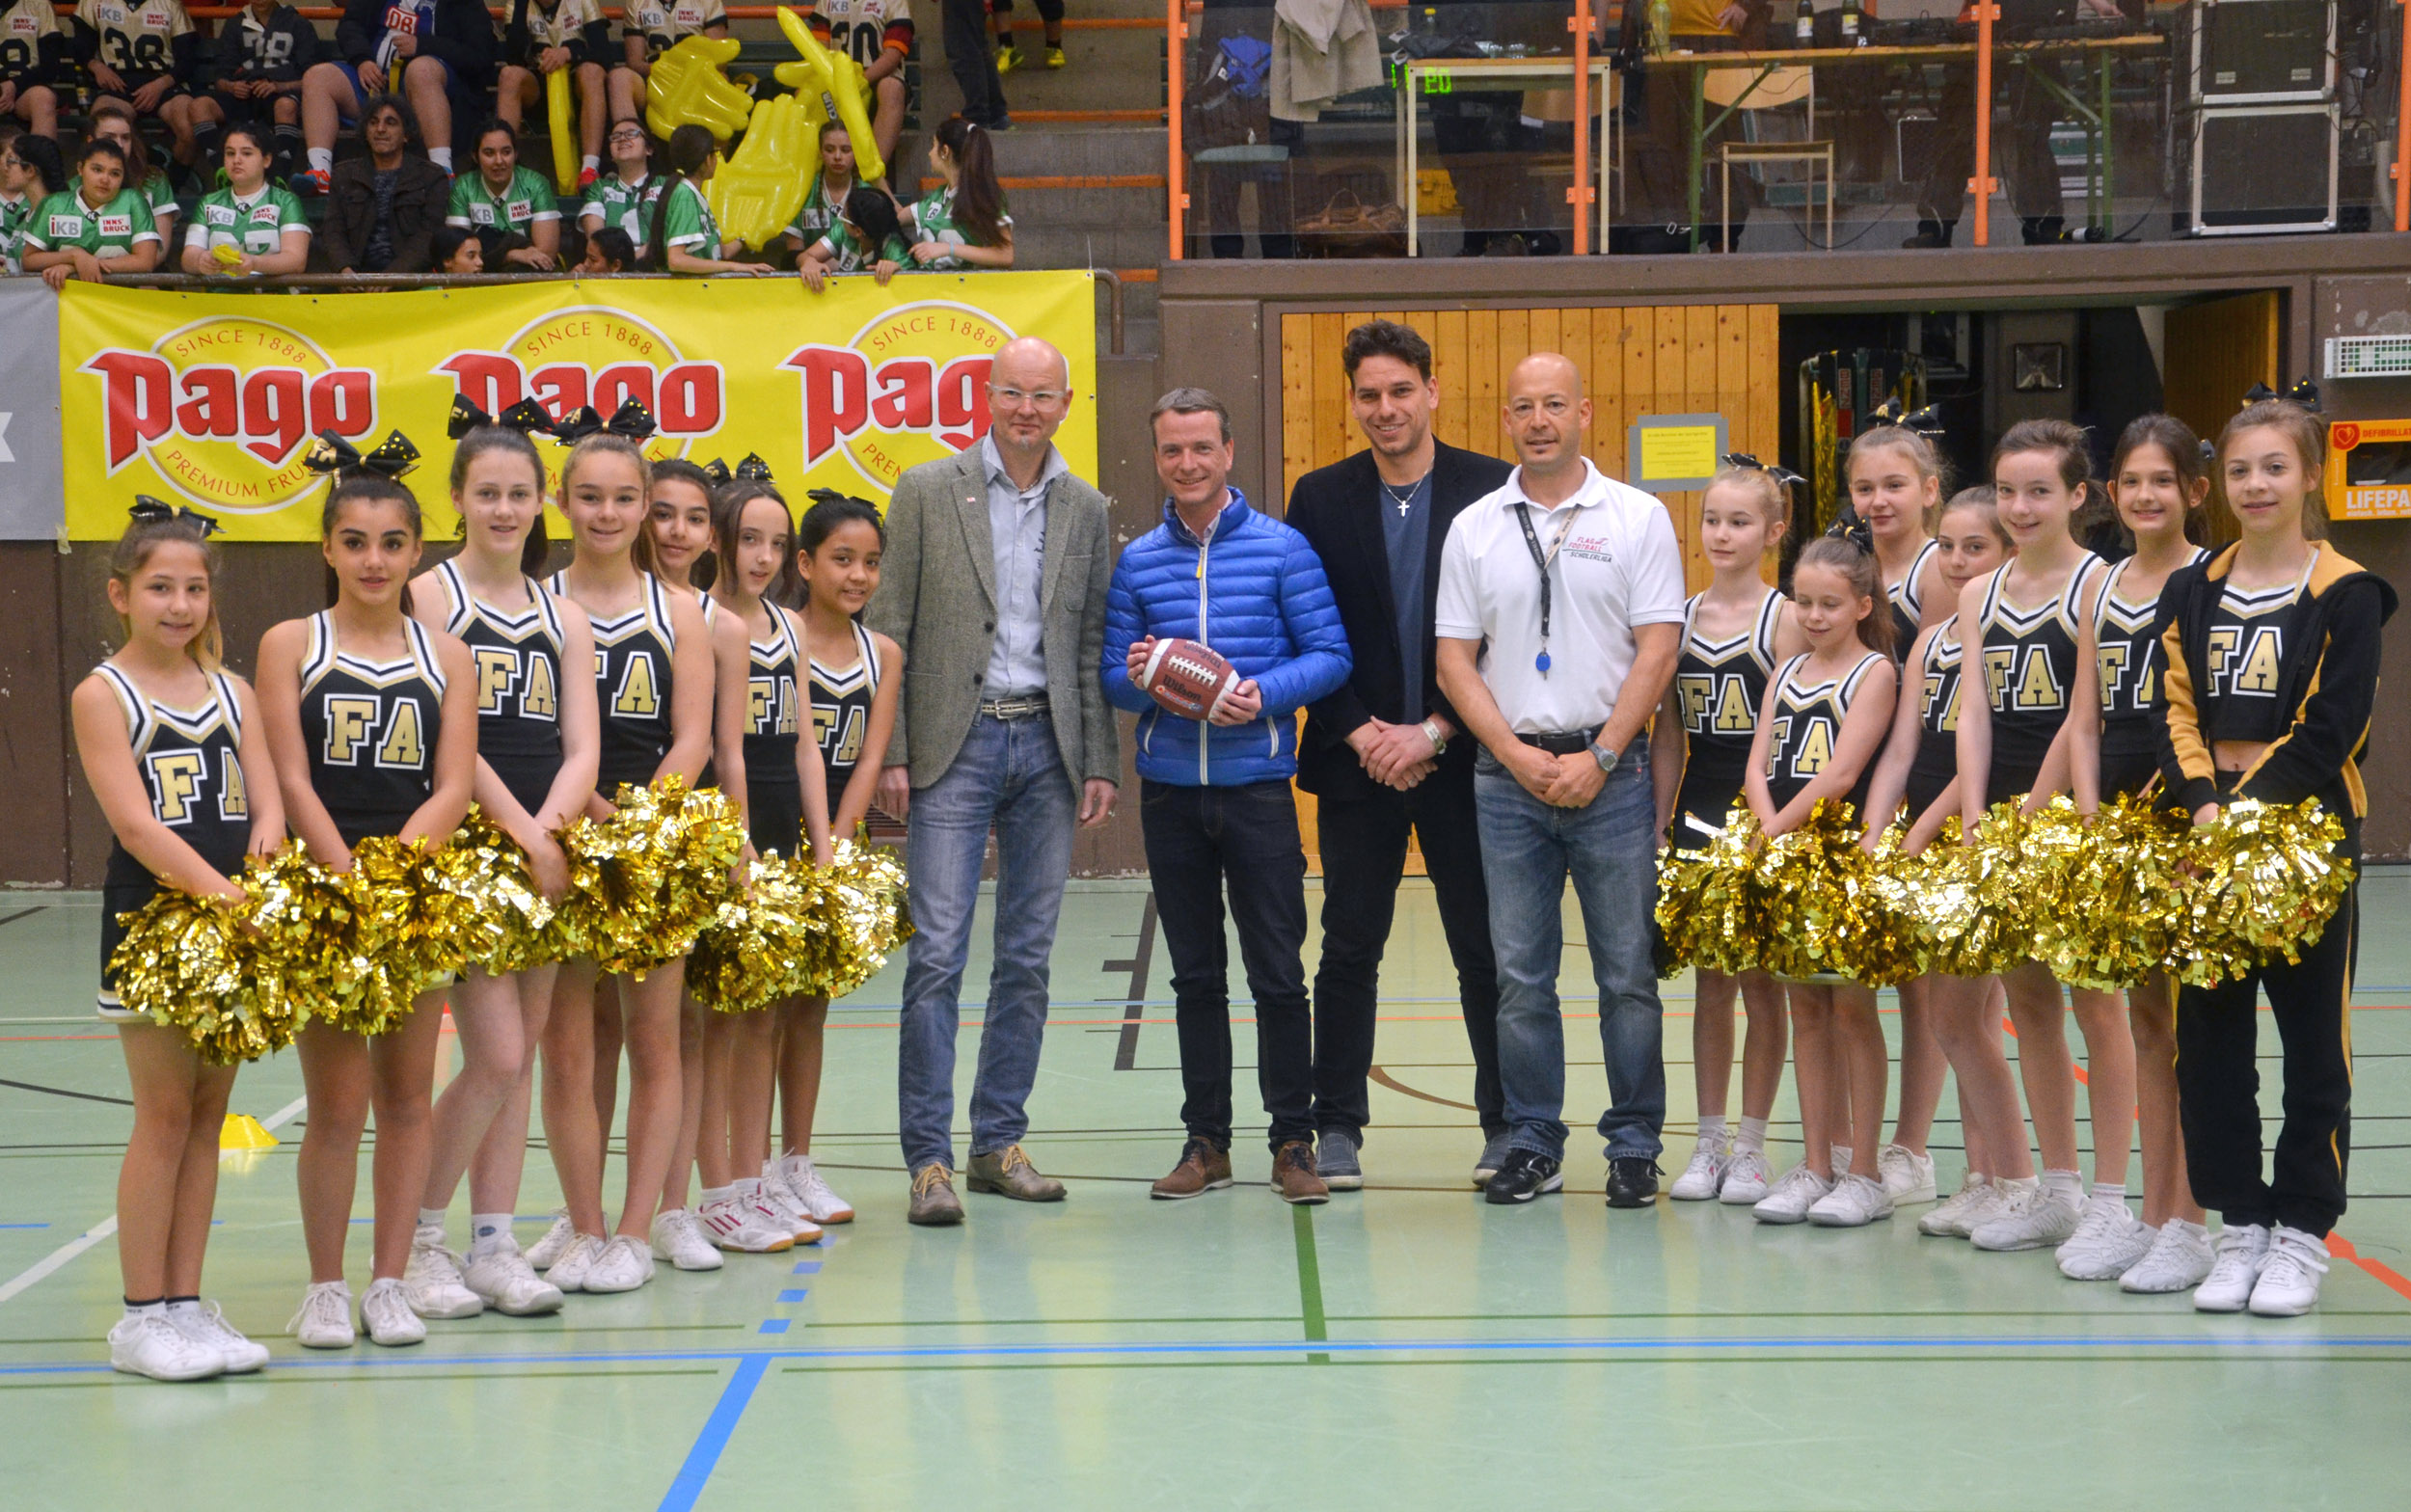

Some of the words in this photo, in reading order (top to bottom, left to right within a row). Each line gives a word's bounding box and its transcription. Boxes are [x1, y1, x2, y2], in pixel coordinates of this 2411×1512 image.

[97, 4, 123, 22] iKB
[638, 11, 663, 26] iKB
[50, 217, 80, 236] iKB
[103, 224, 130, 233] BRUCK
[206, 206, 231, 224] iKB
[511, 209, 531, 219] BRUC
[175, 329, 245, 358] SINCE
[257, 332, 308, 364] 1888
[527, 321, 592, 358] SINCE
[604, 323, 654, 356] 1888
[872, 316, 936, 351] SINCE
[949, 317, 998, 349] 1888
[787, 347, 994, 464] pag
[2362, 427, 2411, 439] DEFIBRILLAT
[166, 449, 259, 498] PREMIUM
[2346, 489, 2411, 510] LIFEPA
[1568, 541, 1604, 553] FOOTBALL
[1577, 536, 1595, 545] FLAG
[1983, 643, 2065, 713] FA
[2208, 625, 2283, 698] FA
[470, 644, 557, 722] FA
[1161, 673, 1203, 702] Wilson
[745, 675, 799, 736] FA
[1676, 672, 1758, 735] FA
[323, 692, 426, 770] FA
[1766, 716, 1835, 781] FA
[145, 746, 249, 826] FA
